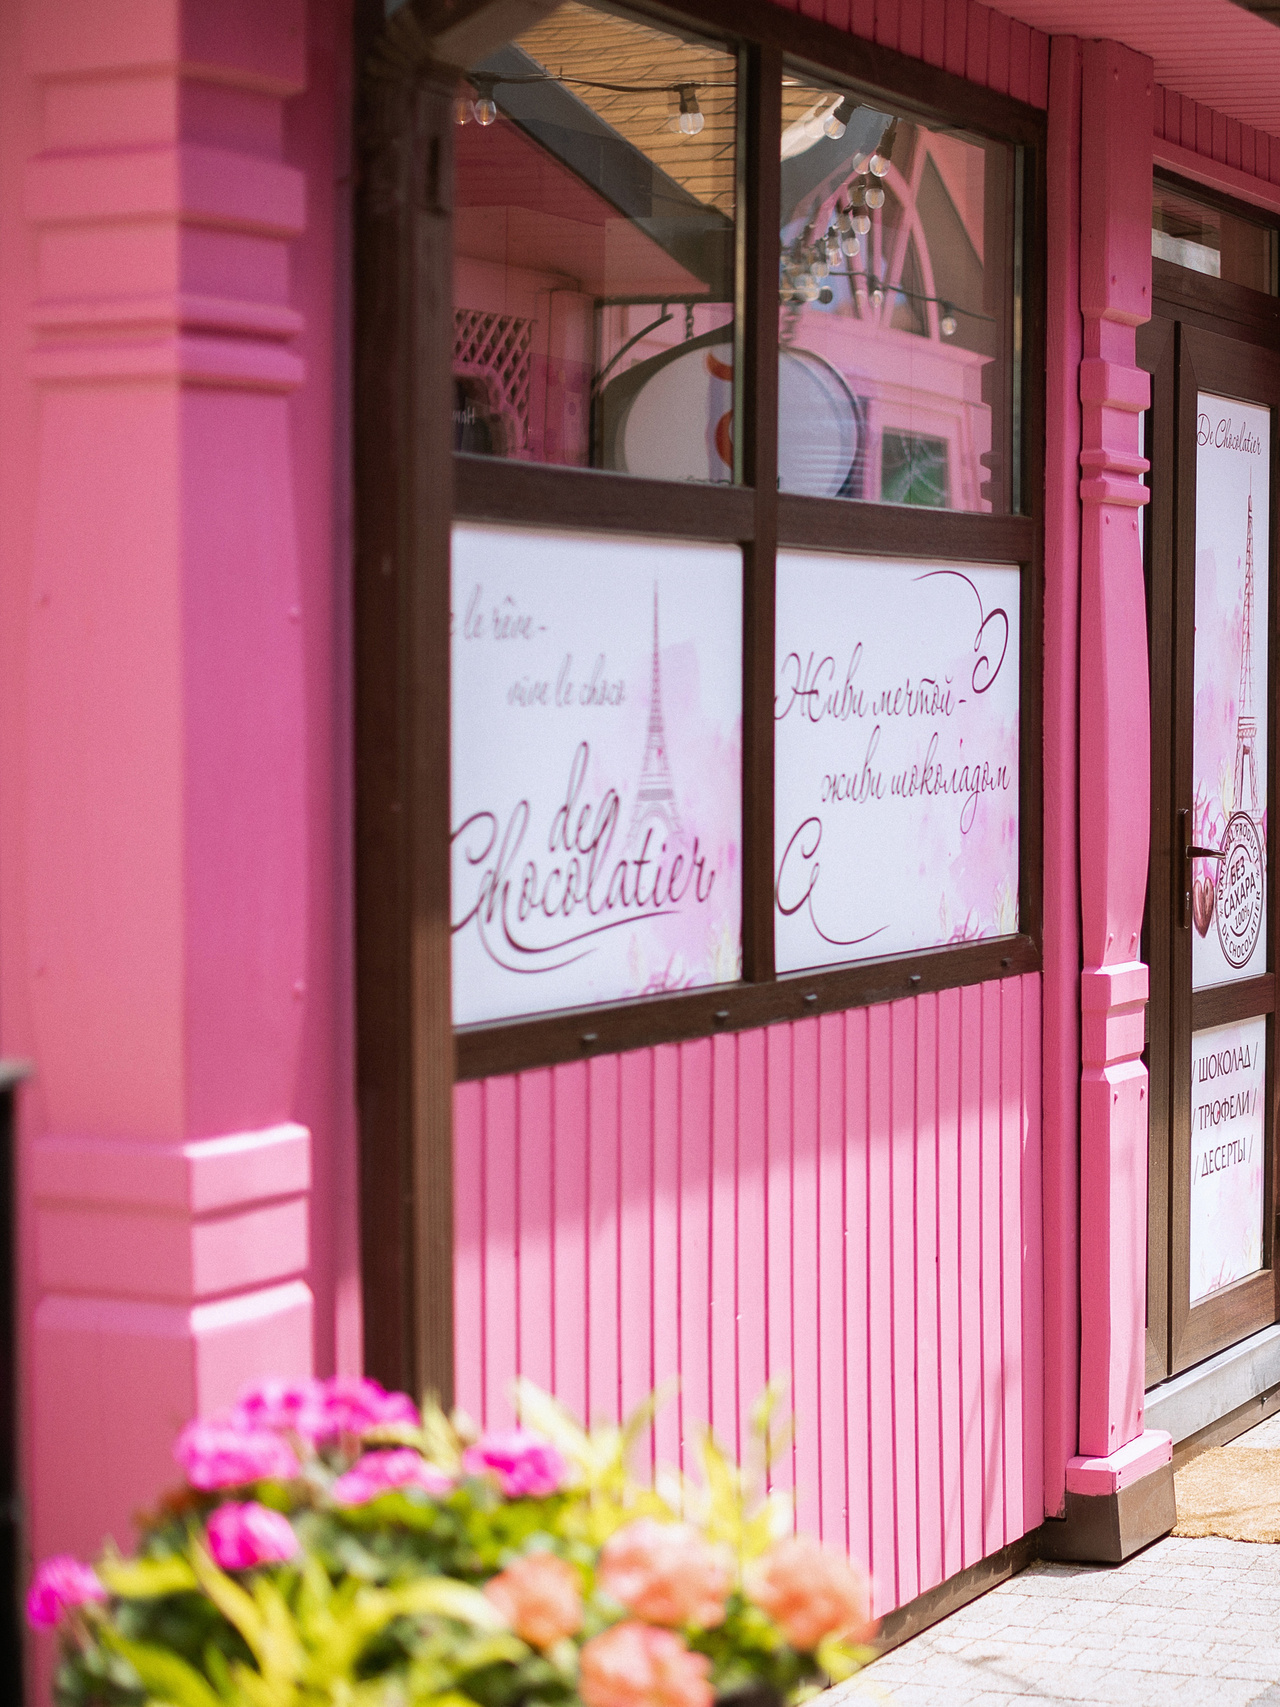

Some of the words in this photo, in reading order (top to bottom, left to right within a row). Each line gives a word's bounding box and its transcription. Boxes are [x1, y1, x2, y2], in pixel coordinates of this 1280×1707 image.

[1230, 855, 1246, 887] БЕЗ
[1223, 871, 1257, 919] САХАРА
[1198, 1045, 1251, 1083] ШОКОЛАД
[1198, 1090, 1250, 1130] ТРЮФЕЛИ
[1201, 1137, 1246, 1178] ДЕСЕРТЫ
